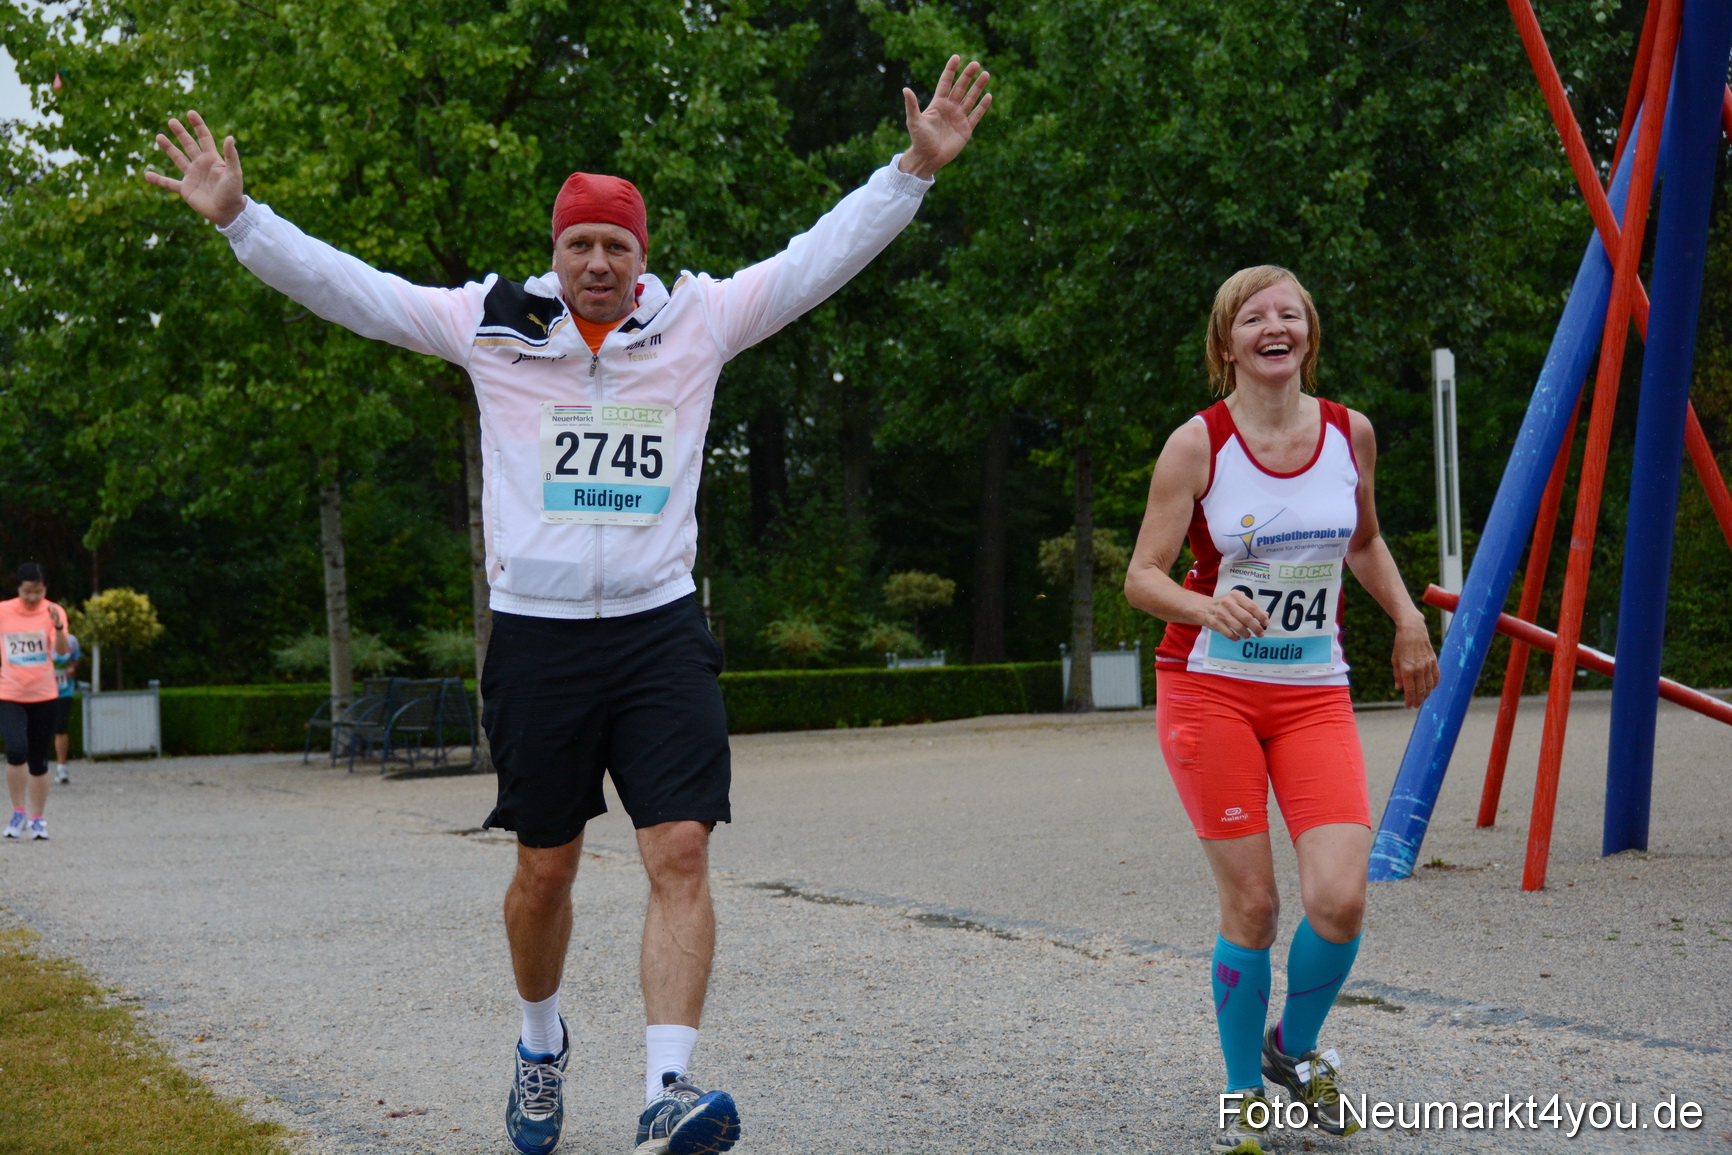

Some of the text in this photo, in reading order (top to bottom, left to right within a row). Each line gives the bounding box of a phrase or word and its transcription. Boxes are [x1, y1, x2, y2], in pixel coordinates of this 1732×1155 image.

[627, 351, 658, 363] Tennis
[601, 406, 663, 423] BOCK
[555, 431, 663, 479] 2745
[574, 489, 642, 511] Rüdiger
[1256, 528, 1336, 547] Physiotherapie
[1229, 568, 1271, 580] NeuerMarkt
[1279, 563, 1333, 579] BOCK
[10, 639, 43, 654] 2701
[1242, 641, 1303, 661] Claudia
